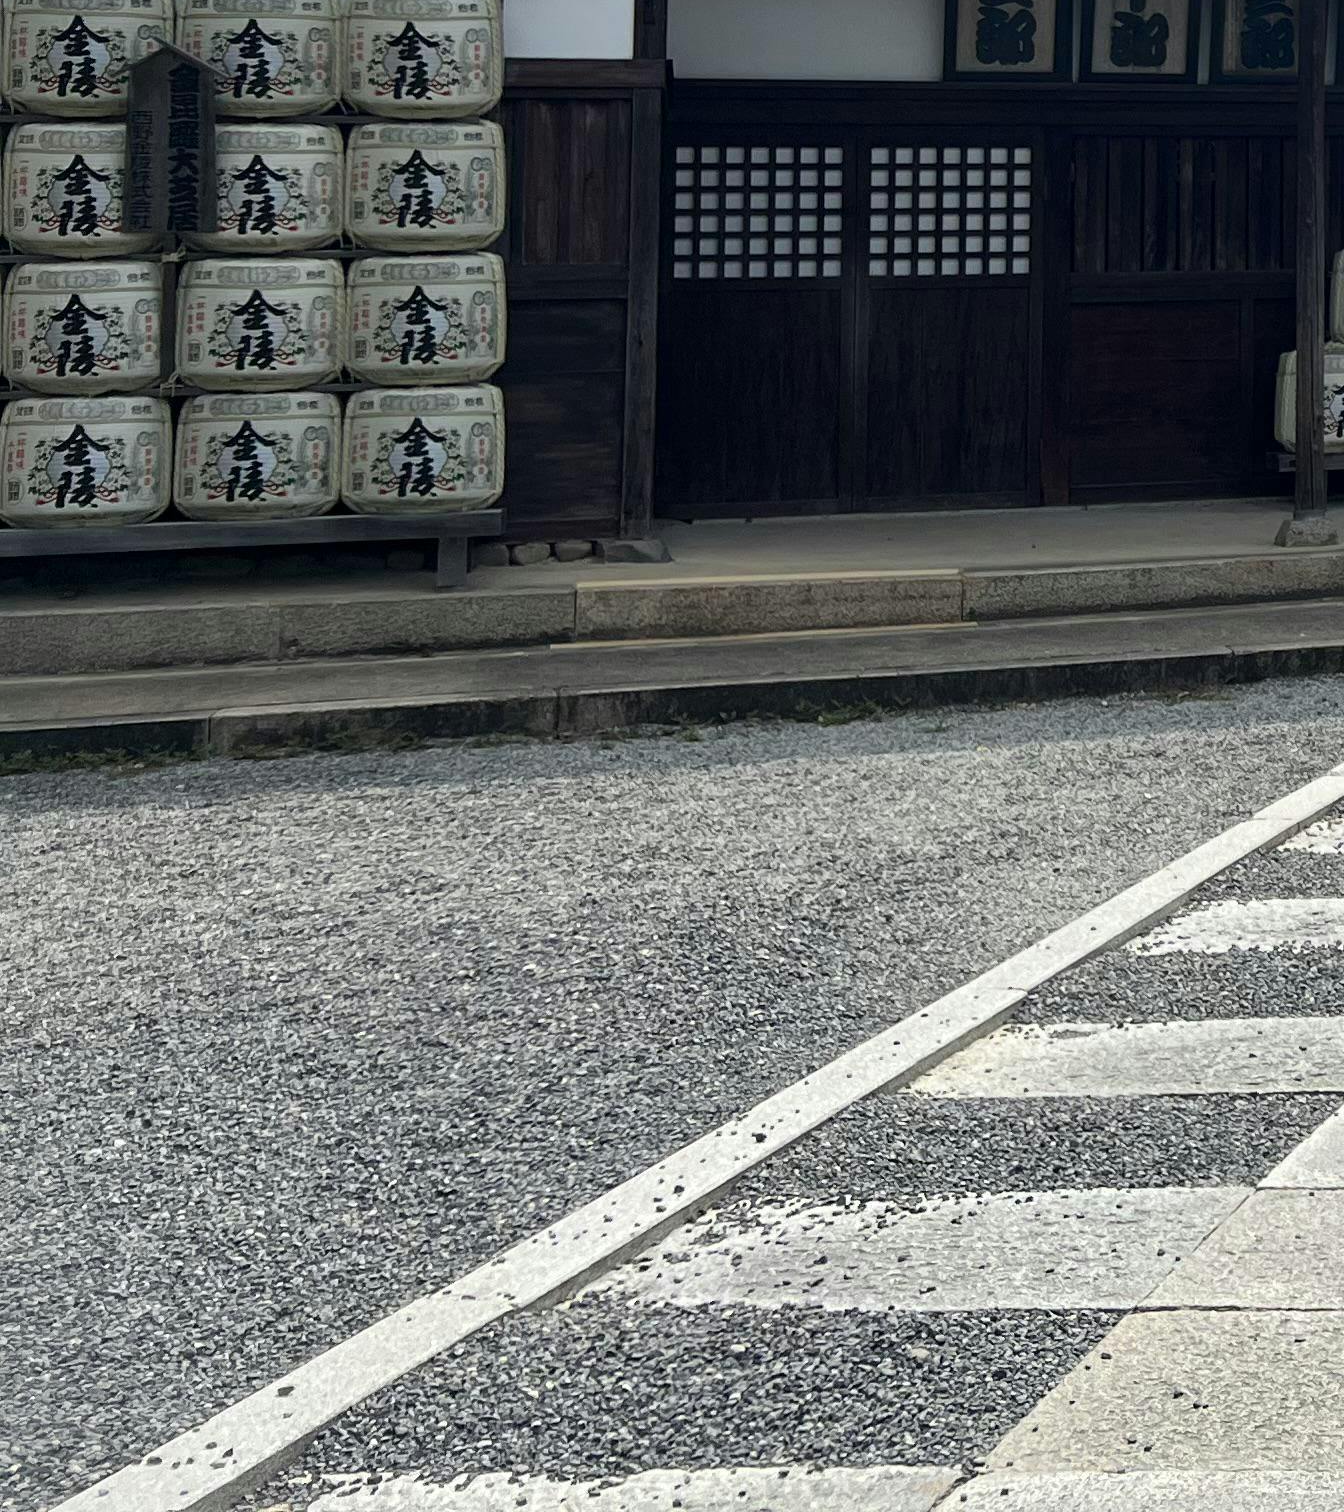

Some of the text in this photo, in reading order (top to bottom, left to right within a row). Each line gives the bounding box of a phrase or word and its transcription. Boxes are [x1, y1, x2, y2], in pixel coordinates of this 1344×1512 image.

[54, 15, 106, 99] 金陵
[227, 19, 281, 99] 金陵
[384, 22, 439, 100] 金陵
[54, 155, 109, 237] 金陵
[229, 155, 285, 237] 金陵
[392, 149, 446, 231] 金陵
[50, 294, 105, 376] 金陵
[230, 290, 285, 371] 金陵
[393, 286, 447, 366] 金陵
[52, 424, 108, 509] 金陵
[223, 420, 278, 502] 金陵
[392, 418, 446, 497] 金陵
